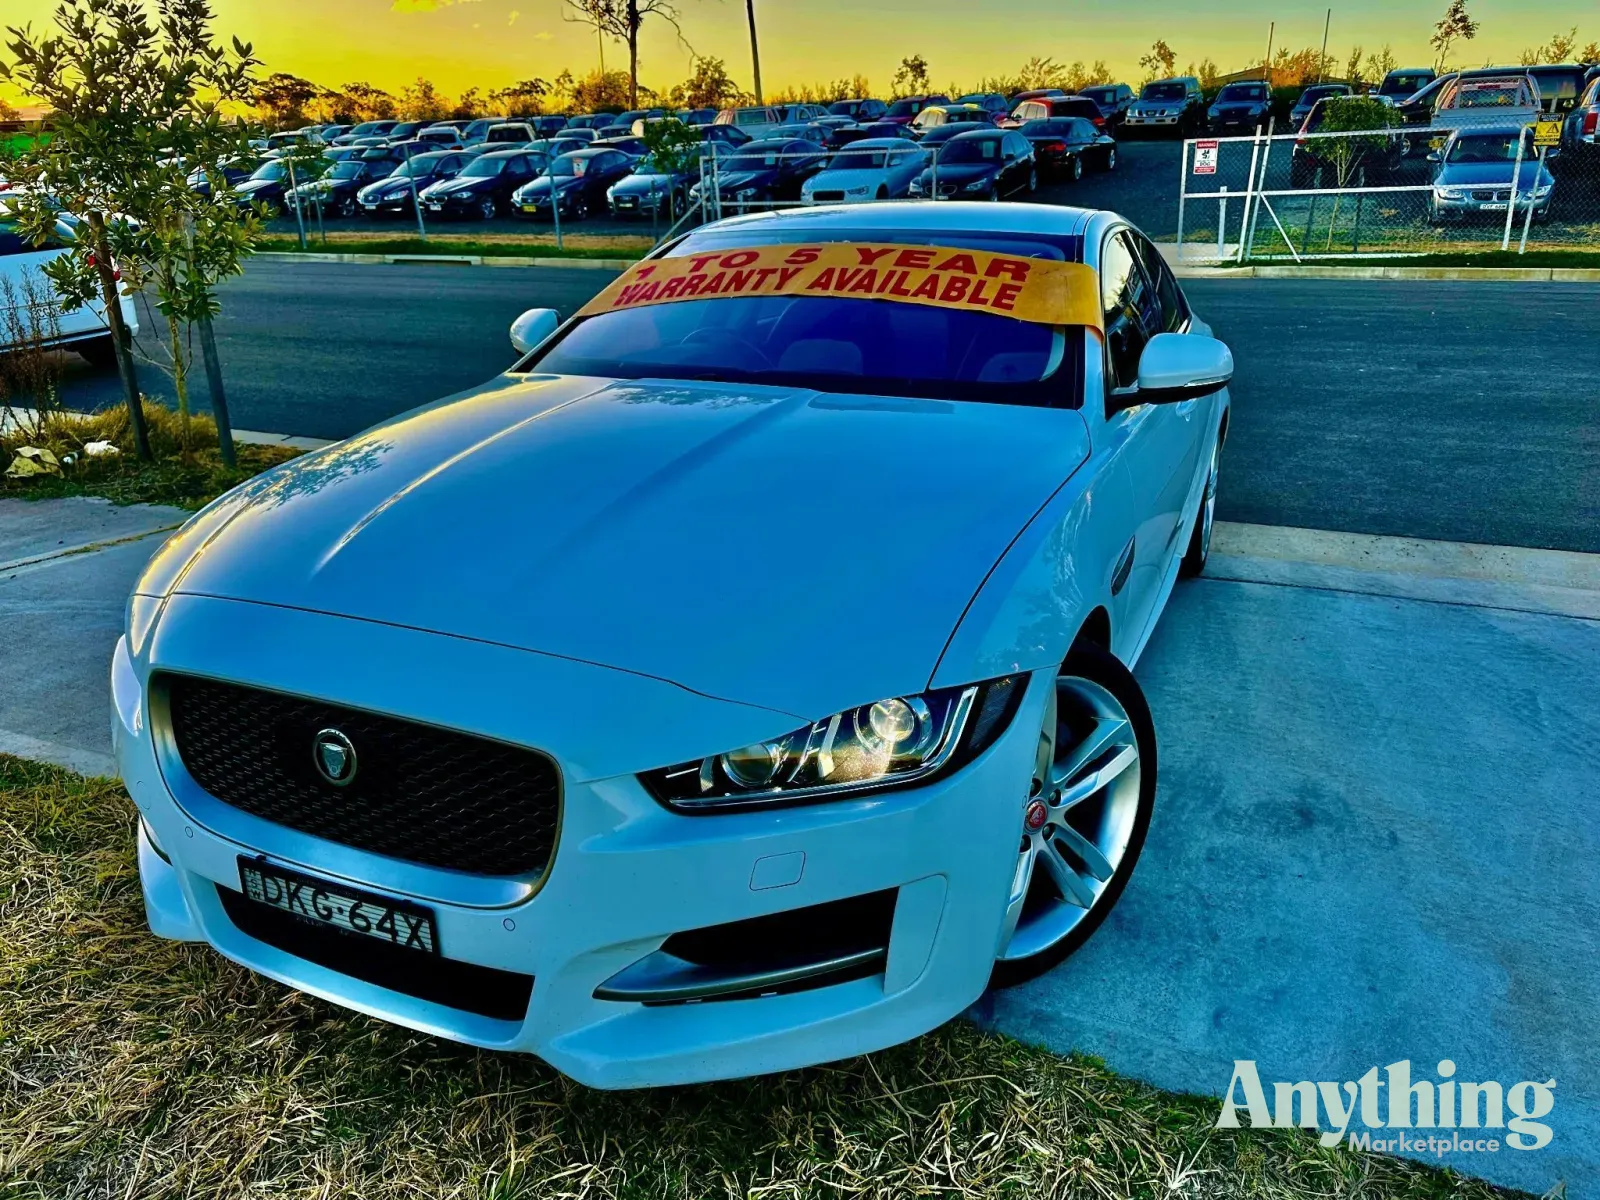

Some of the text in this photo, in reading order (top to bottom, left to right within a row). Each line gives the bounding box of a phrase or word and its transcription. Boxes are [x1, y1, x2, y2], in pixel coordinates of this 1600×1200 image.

[636, 247, 1031, 283] 1 TO 5 YEAR
[612, 267, 1023, 311] WARRANTY AVAILABLE
